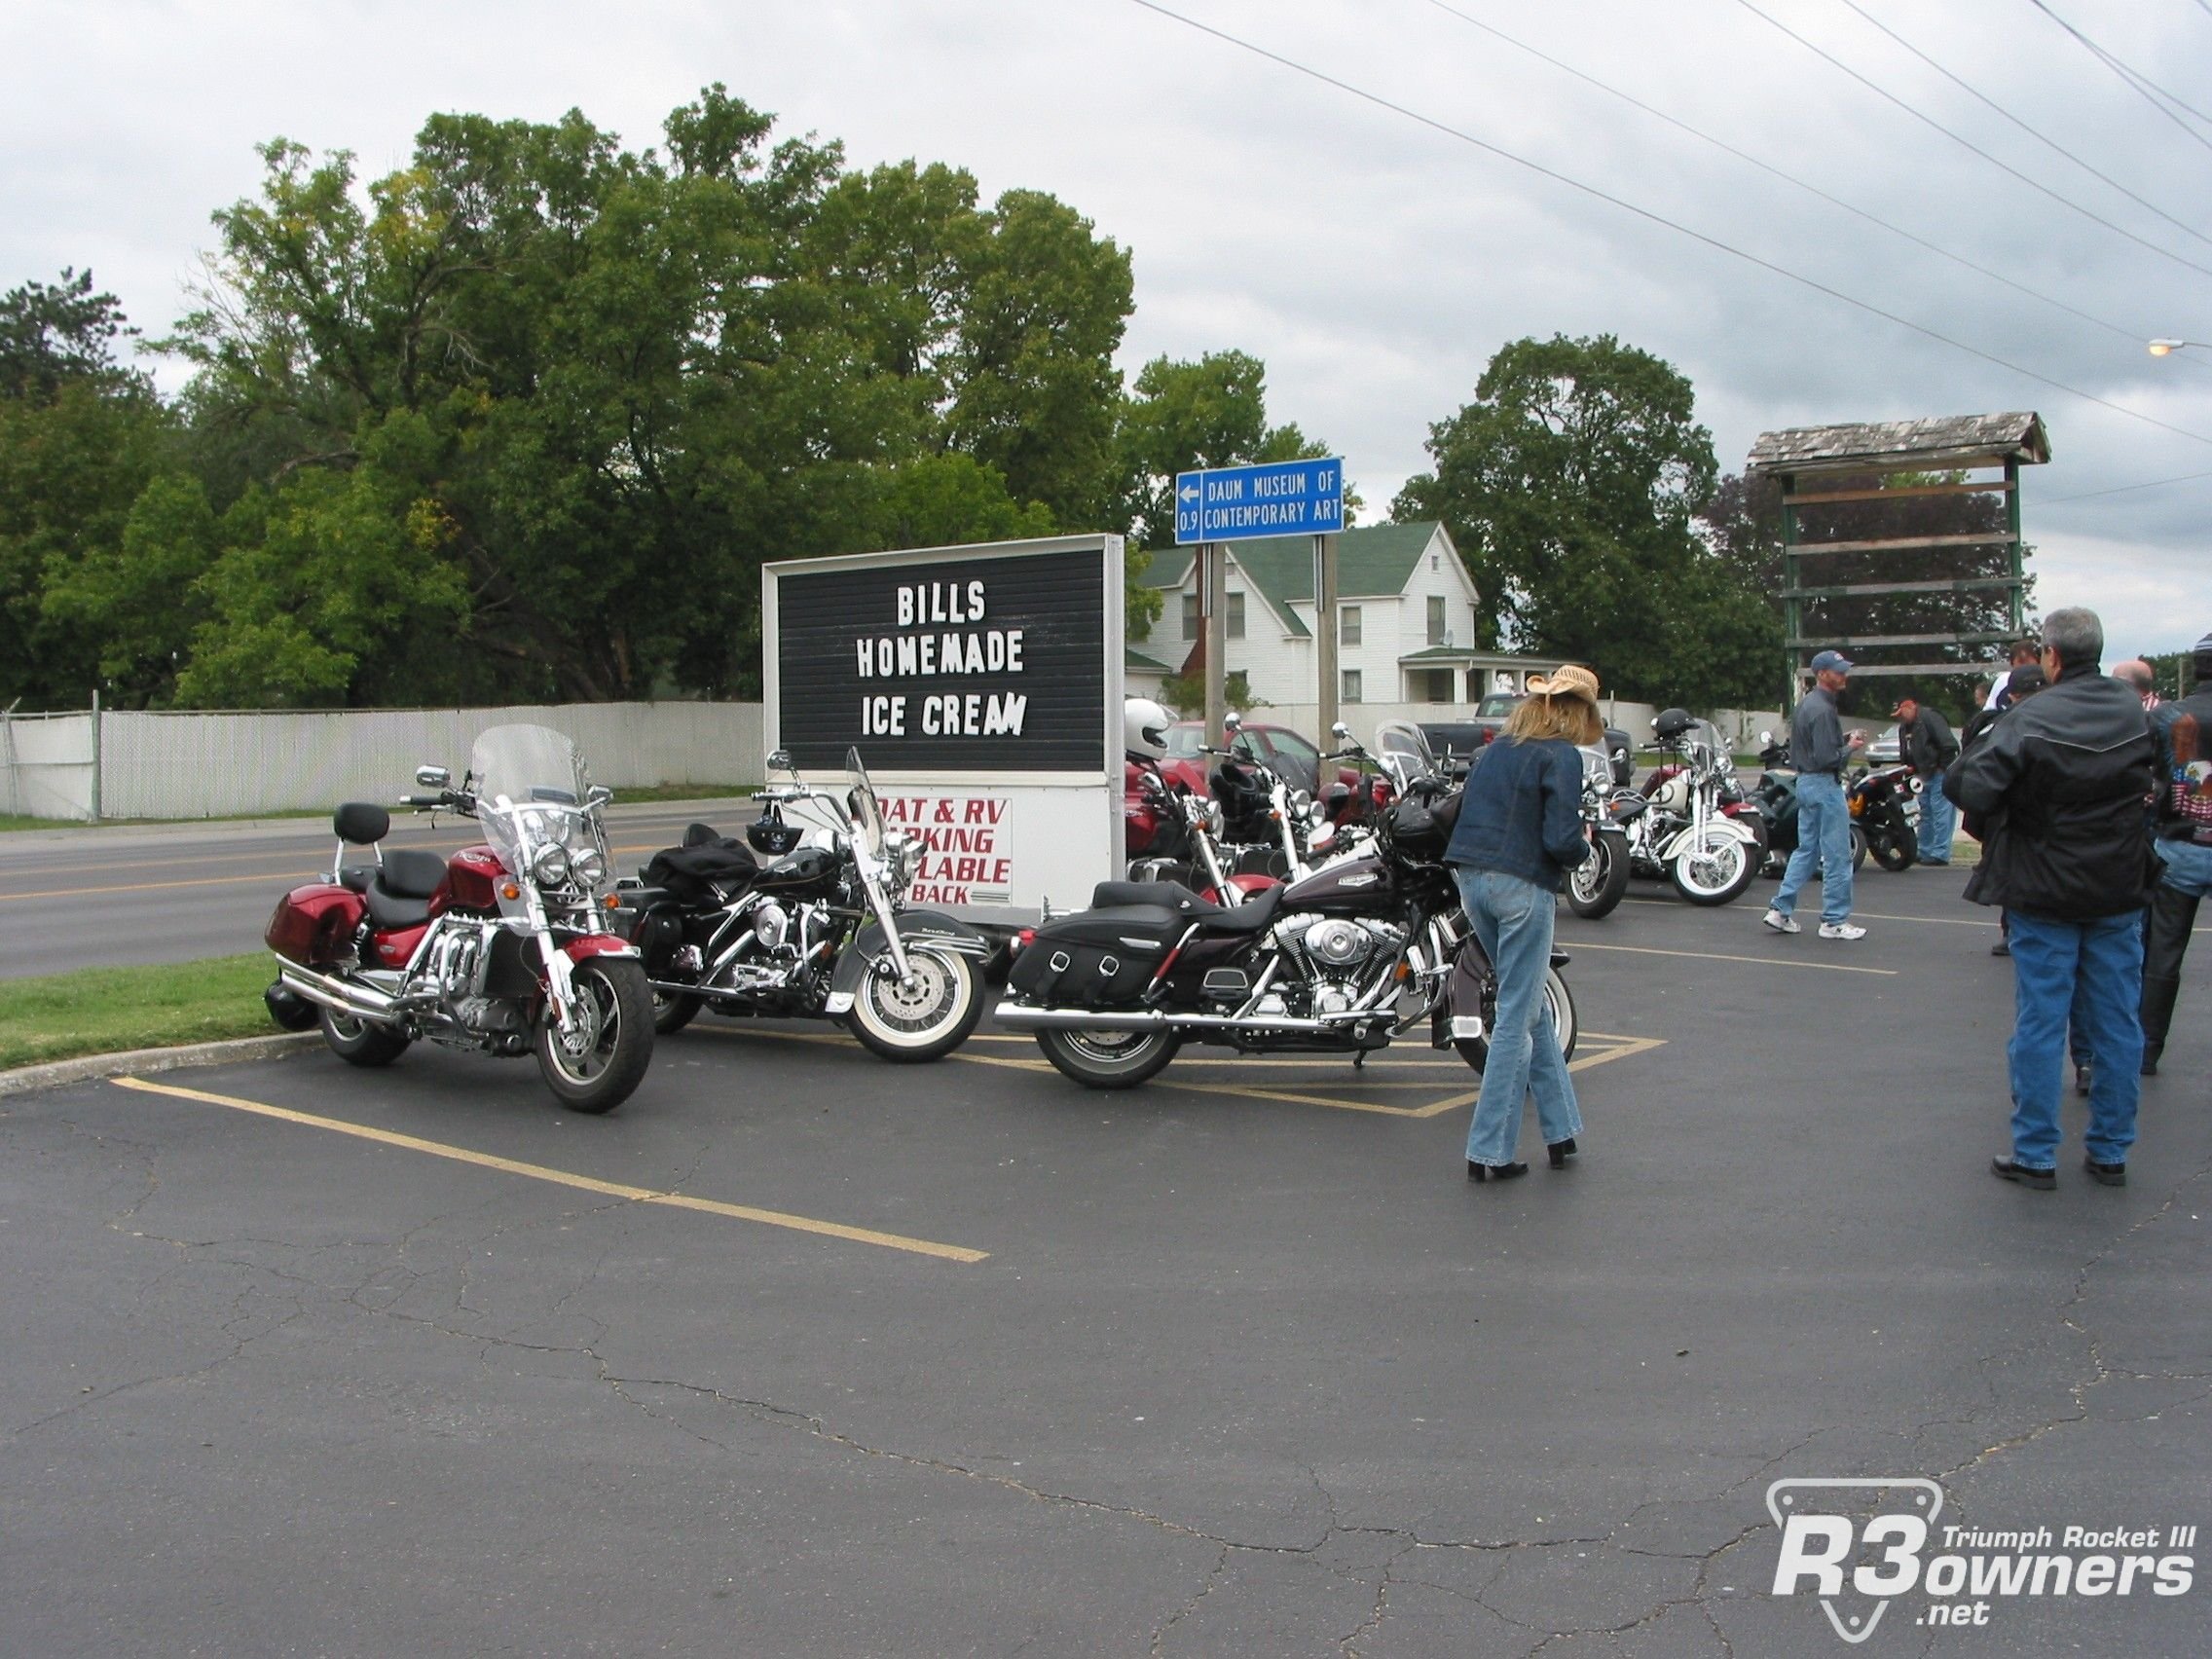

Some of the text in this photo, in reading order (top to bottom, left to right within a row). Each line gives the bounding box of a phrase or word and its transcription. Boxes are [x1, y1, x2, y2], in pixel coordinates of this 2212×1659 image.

[1207, 470, 1335, 501] DAUM MUSEUM OF
[1179, 511, 1198, 532] 0.9
[1204, 498, 1340, 529] CONTEMPORARY ART
[897, 580, 986, 626] BILLS
[856, 630, 1024, 678] HOMEMADE
[861, 692, 1028, 736] ICE CREAM
[853, 798, 1008, 824] AT & RV
[890, 827, 995, 853] KING
[917, 856, 1012, 883] LABLE
[911, 884, 969, 903] BACK
